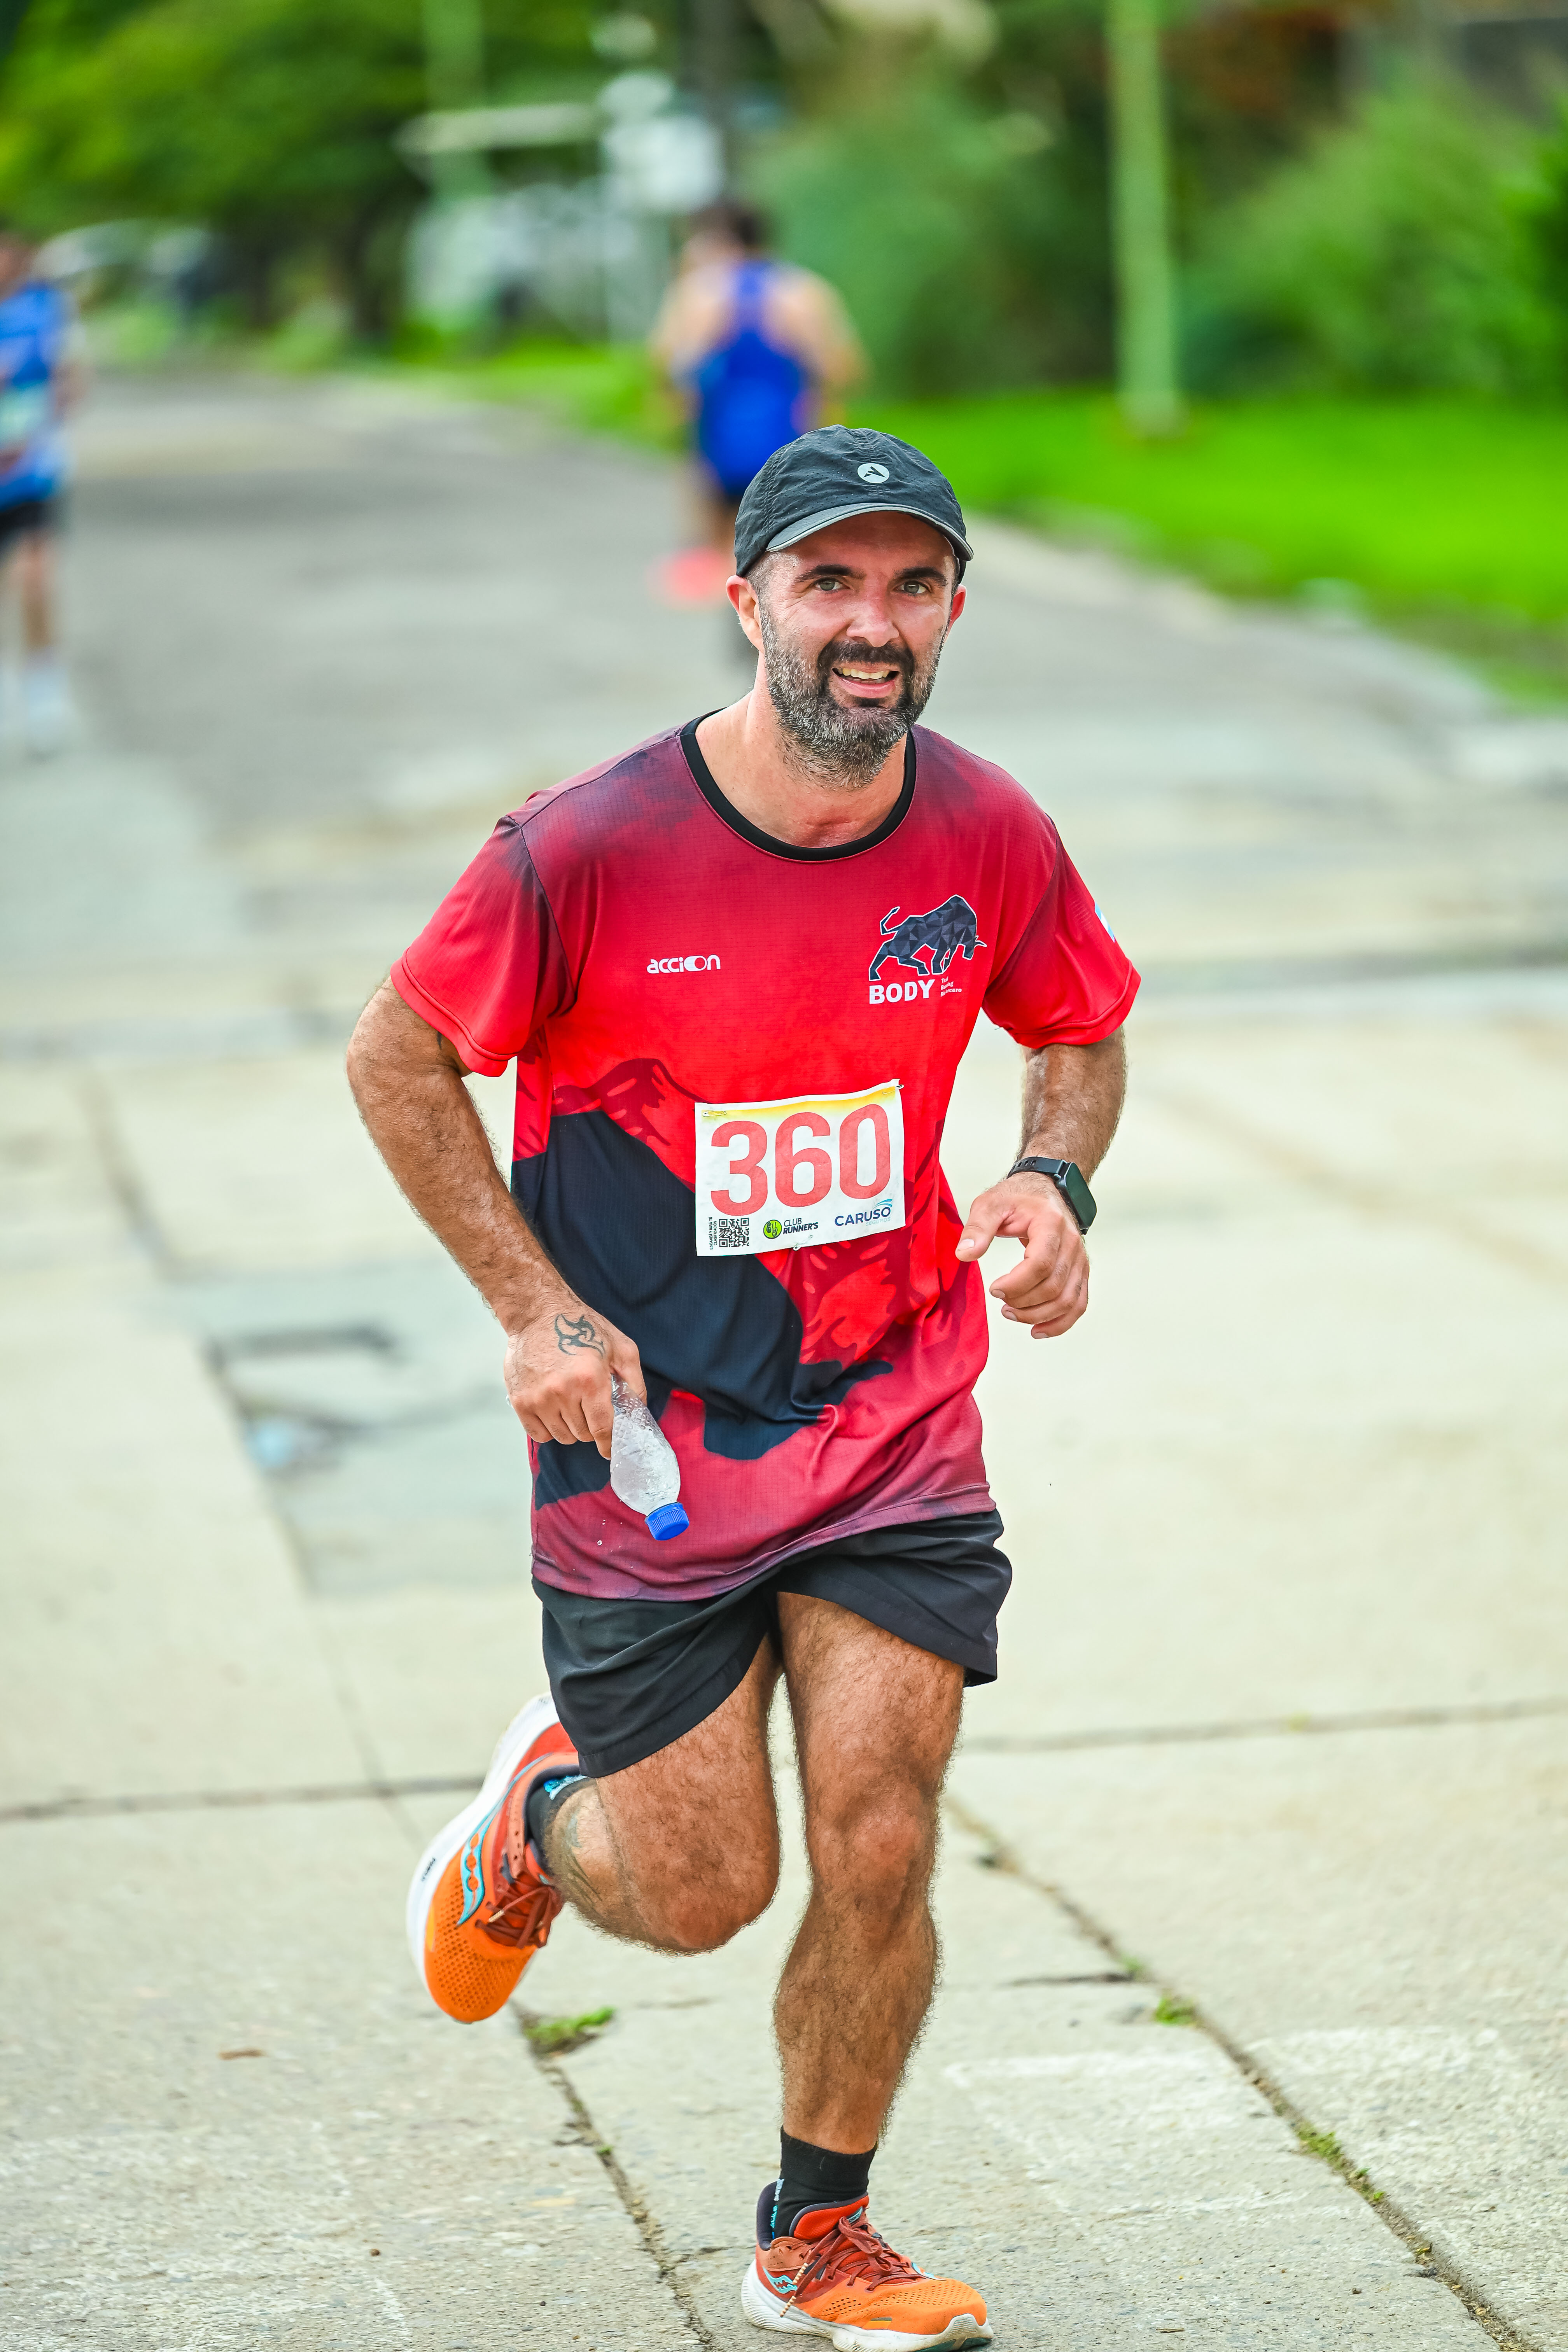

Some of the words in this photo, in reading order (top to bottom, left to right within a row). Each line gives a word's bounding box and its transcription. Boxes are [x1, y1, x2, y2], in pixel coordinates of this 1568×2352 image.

[869, 979, 935, 1004] BODY
[711, 1104, 891, 1216] 360
[784, 1218, 802, 1227] CLUB
[835, 1207, 891, 1226] CARUSO
[865, 1217, 891, 1226] SEGUROS
[783, 1222, 819, 1234] RUNNER'S
